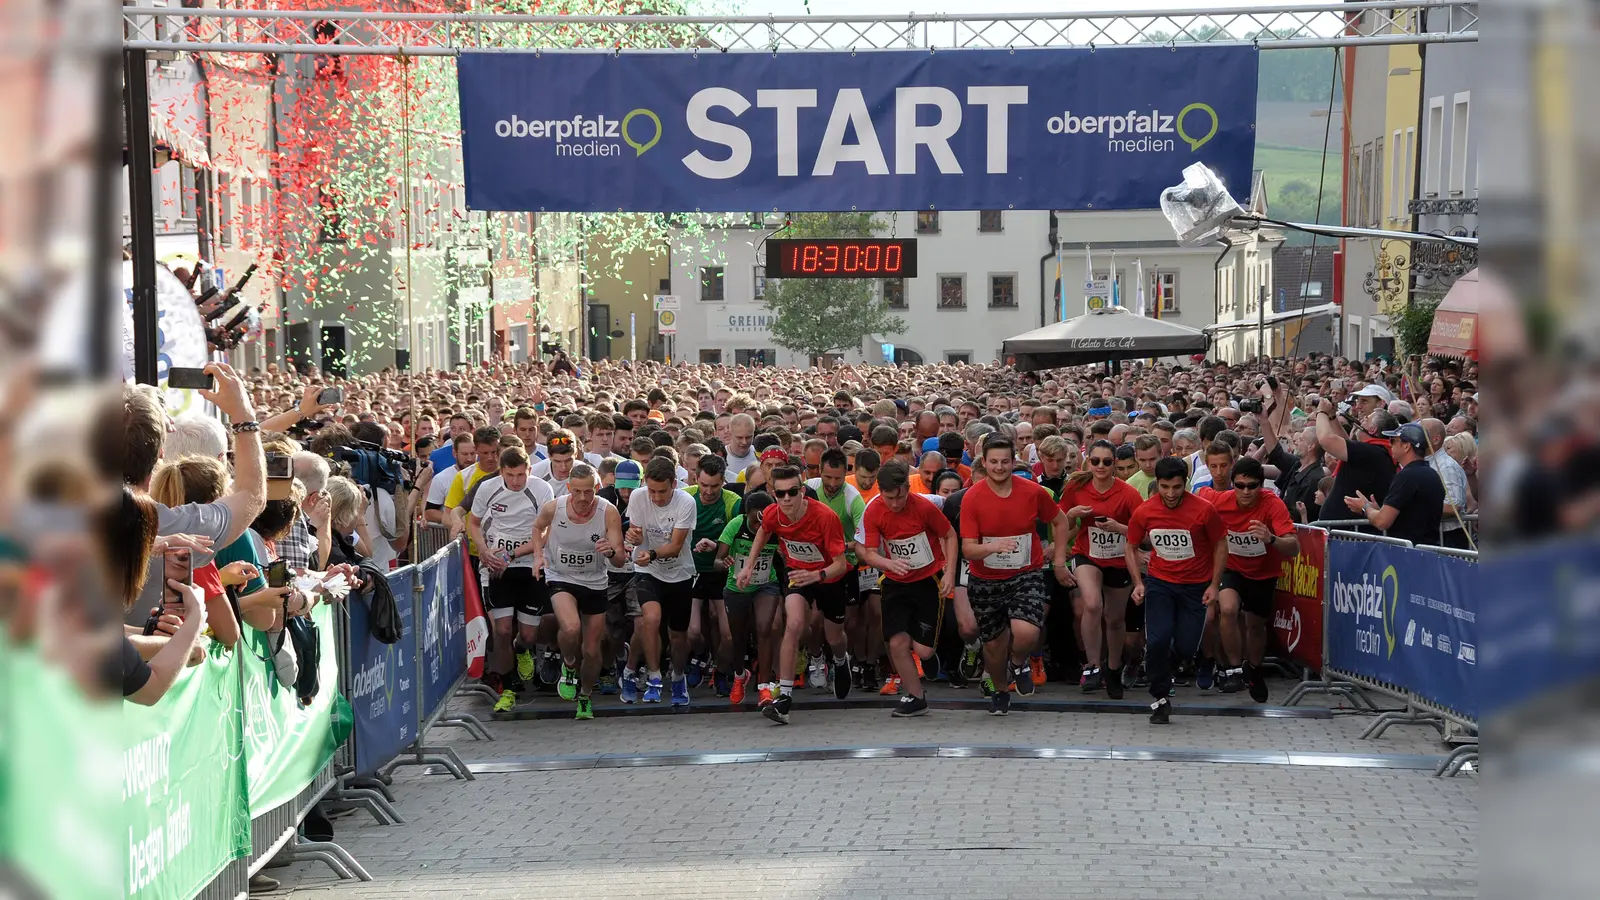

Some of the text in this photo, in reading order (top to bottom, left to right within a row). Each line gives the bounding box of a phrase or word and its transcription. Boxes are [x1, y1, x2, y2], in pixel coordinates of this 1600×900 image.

[495, 114, 619, 142] oberpfalz
[1047, 110, 1174, 138] oberpfalz
[682, 86, 1029, 179] START
[556, 140, 620, 157] medien
[1108, 136, 1174, 152] medien
[792, 245, 901, 272] 18:30:00
[1078, 338, 1102, 349] Gelato
[1104, 338, 1116, 348] Eis
[498, 538, 528, 552] 666
[1092, 532, 1121, 545] 2047
[1154, 534, 1188, 547] 2039
[1228, 534, 1259, 546] 2049
[889, 542, 918, 556] 2052
[560, 553, 593, 565] 5859
[739, 559, 768, 572] 145
